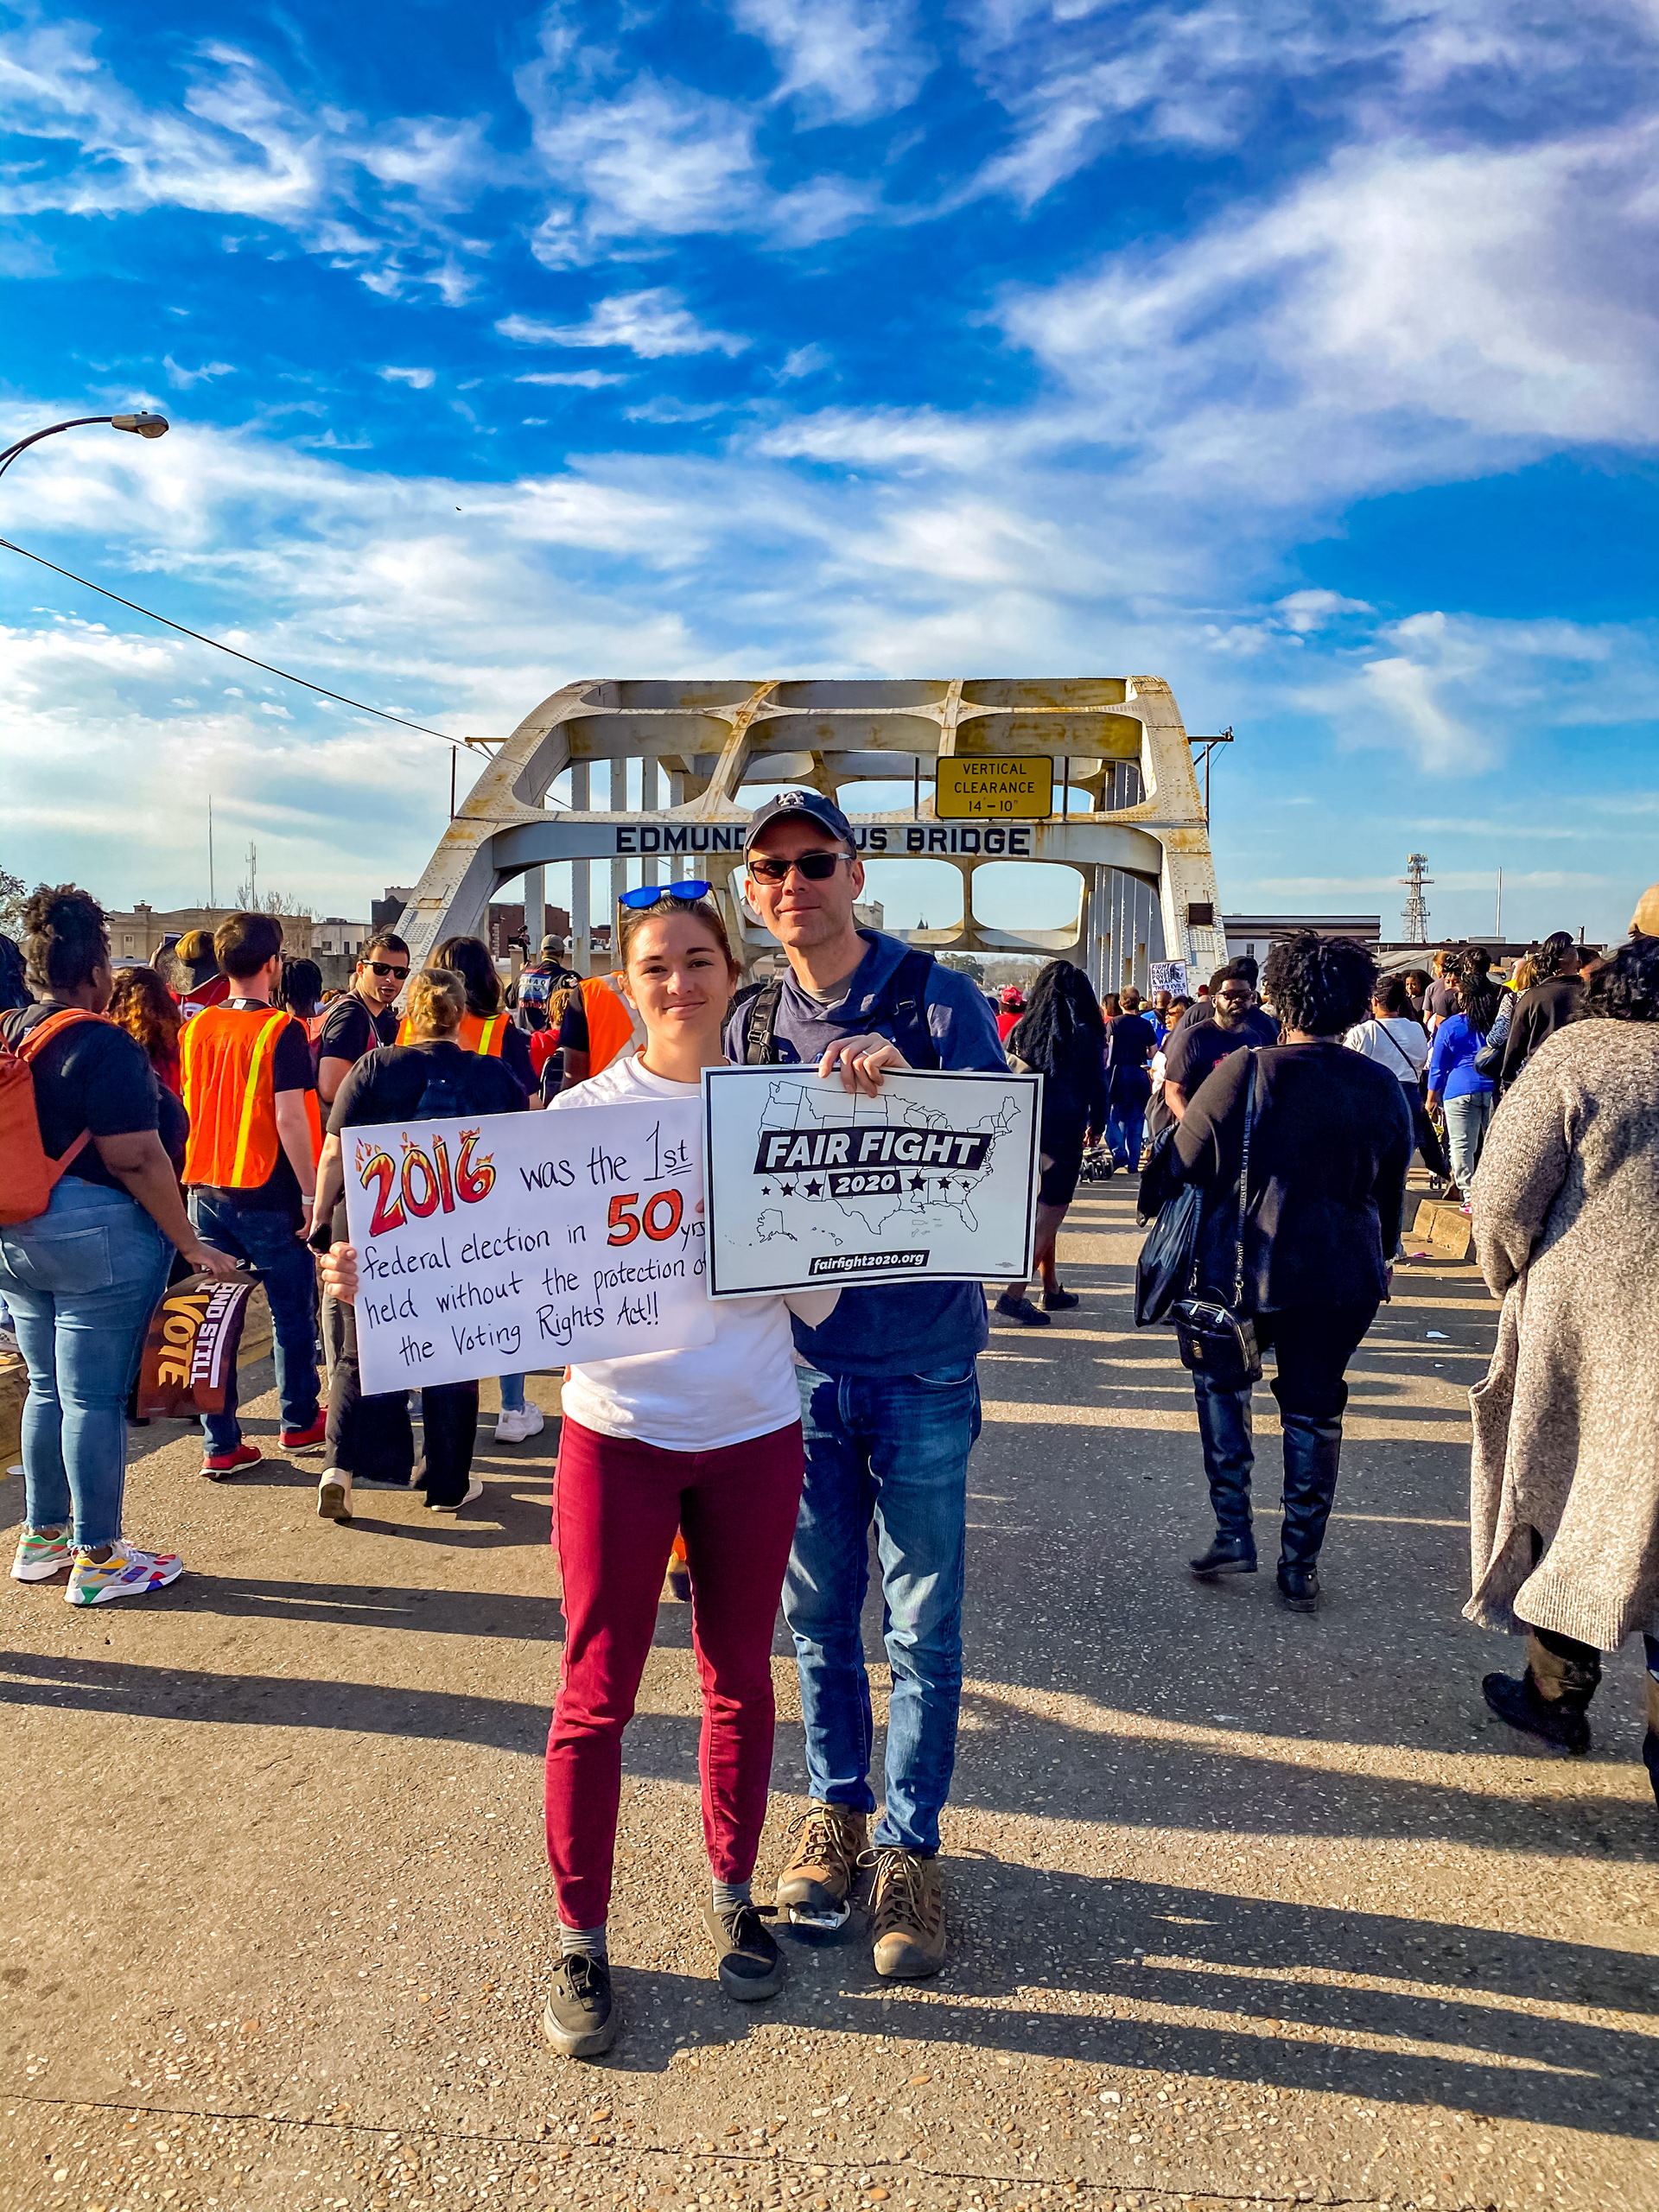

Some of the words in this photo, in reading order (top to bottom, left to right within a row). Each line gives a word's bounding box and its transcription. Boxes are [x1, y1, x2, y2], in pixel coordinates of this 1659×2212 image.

[963, 763, 1027, 775] VERTICAL
[778, 792, 804, 807] LA
[954, 782, 1035, 793] CLEARANCE
[906, 827, 1031, 855] BRIDGE
[766, 1133, 851, 1167] FAIR
[858, 1131, 982, 1165] FIGHT
[359, 1135, 497, 1238] 2016
[519, 1160, 575, 1192] was
[586, 1145, 632, 1185] the
[643, 1120, 694, 1181] 1st
[835, 1173, 896, 1194] 2020
[362, 1236, 451, 1280] federal
[461, 1226, 550, 1264] election
[566, 1224, 587, 1244] in
[813, 1253, 925, 1274] fairfight2020.org
[206, 1282, 239, 1319] AND
[364, 1287, 419, 1330] held
[435, 1270, 524, 1313] without
[541, 1267, 580, 1296] the
[593, 1258, 685, 1306] protection
[158, 1294, 210, 1389] VOTE
[399, 1334, 435, 1367] the
[451, 1323, 521, 1355] Voting
[536, 1303, 605, 1347] Rights
[616, 1291, 659, 1325] Act!!
